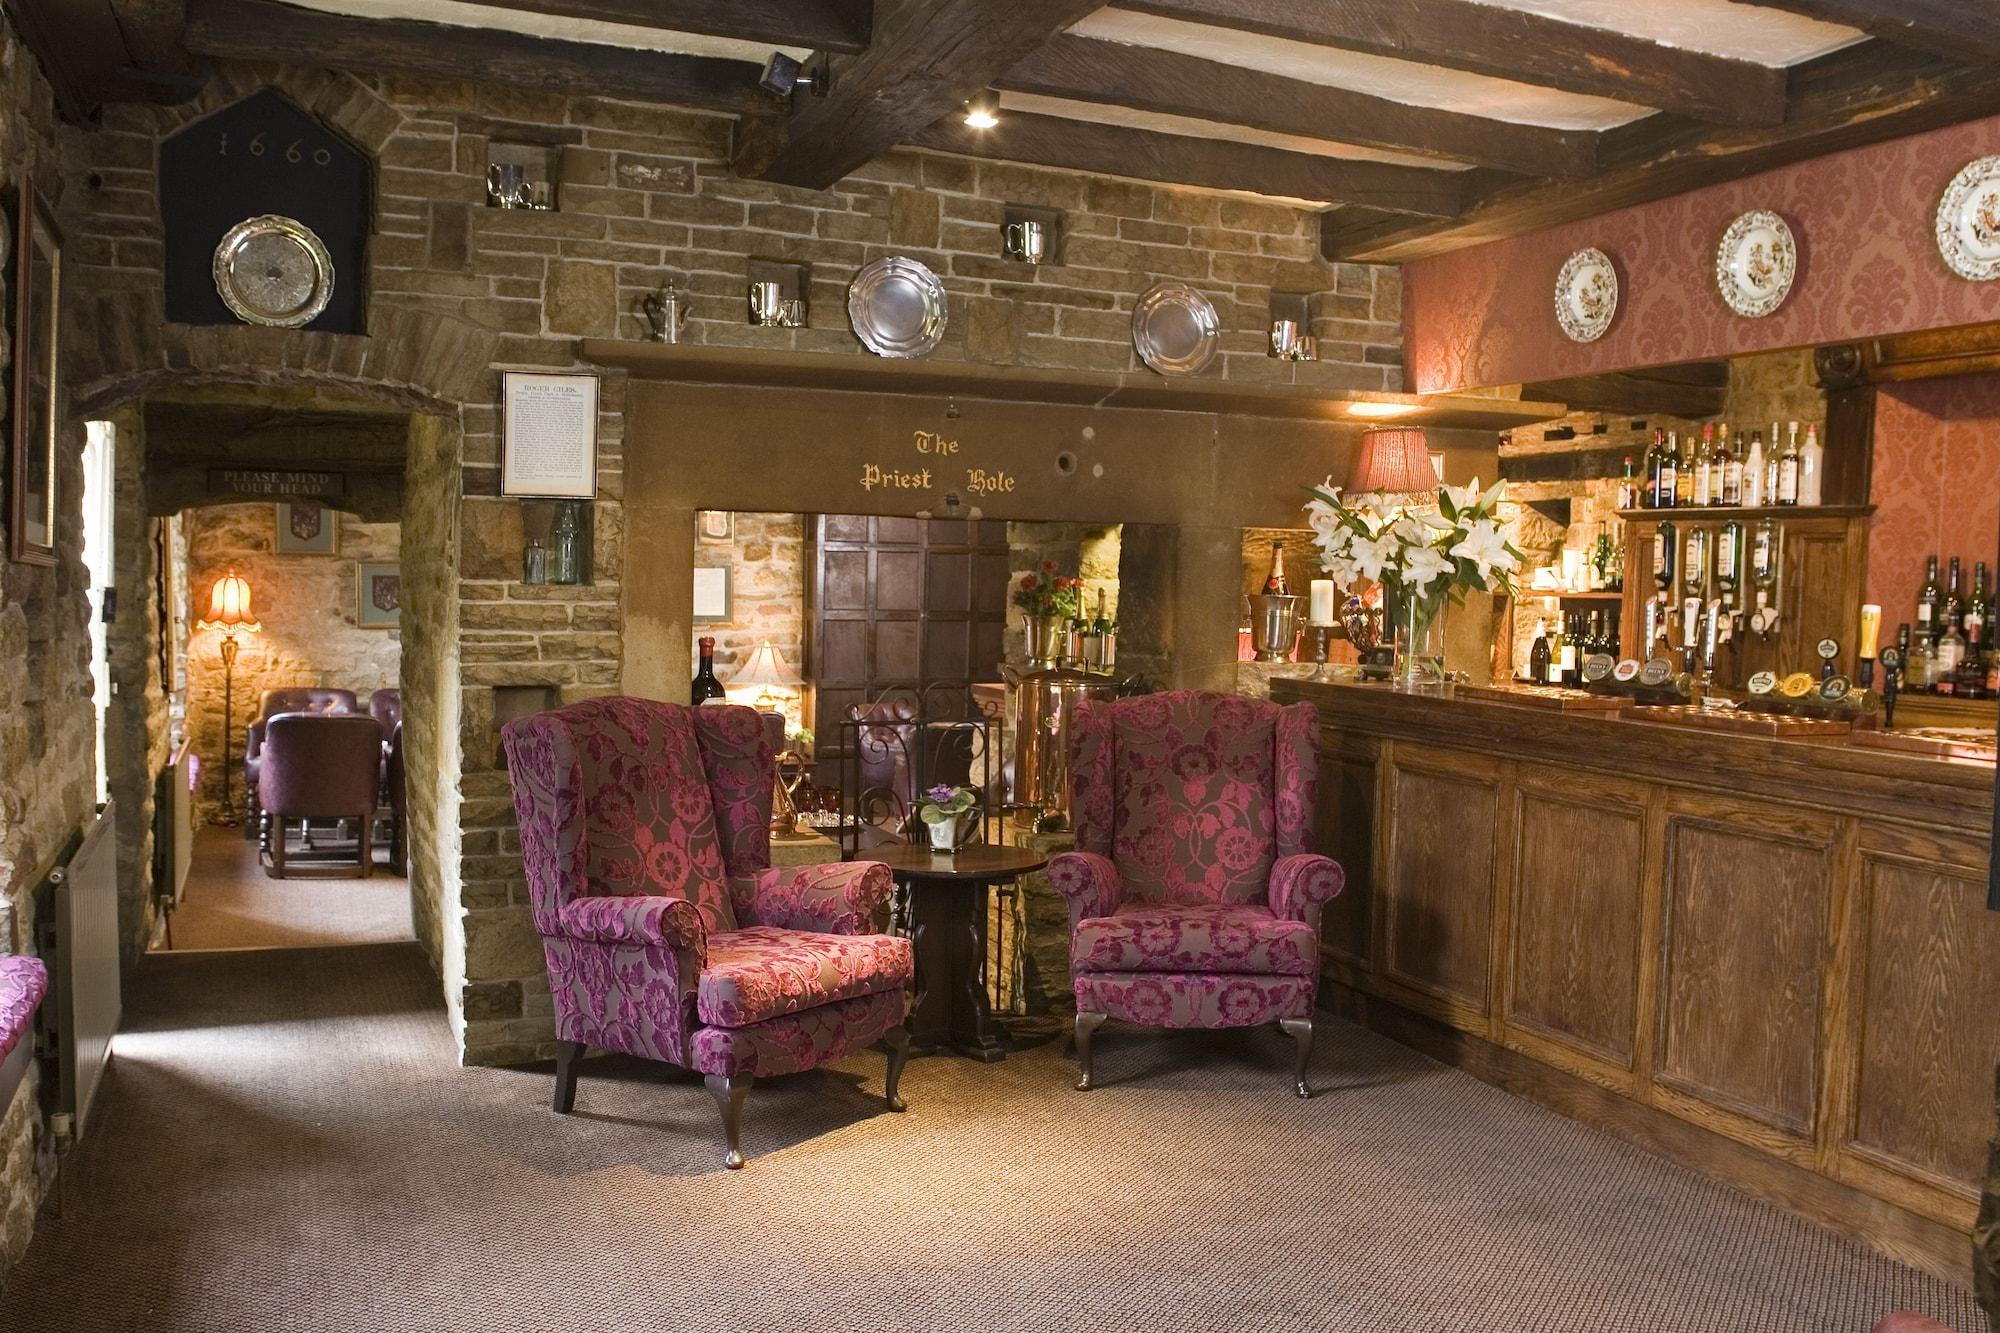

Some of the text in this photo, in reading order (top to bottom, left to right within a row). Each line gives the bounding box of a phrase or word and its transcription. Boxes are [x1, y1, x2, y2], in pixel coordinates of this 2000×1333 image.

[913, 430, 960, 456] The
[223, 470, 329, 485] PLEASE MIND
[860, 463, 1016, 497] Priest Hole
[232, 482, 322, 495] YOUR HEAD
